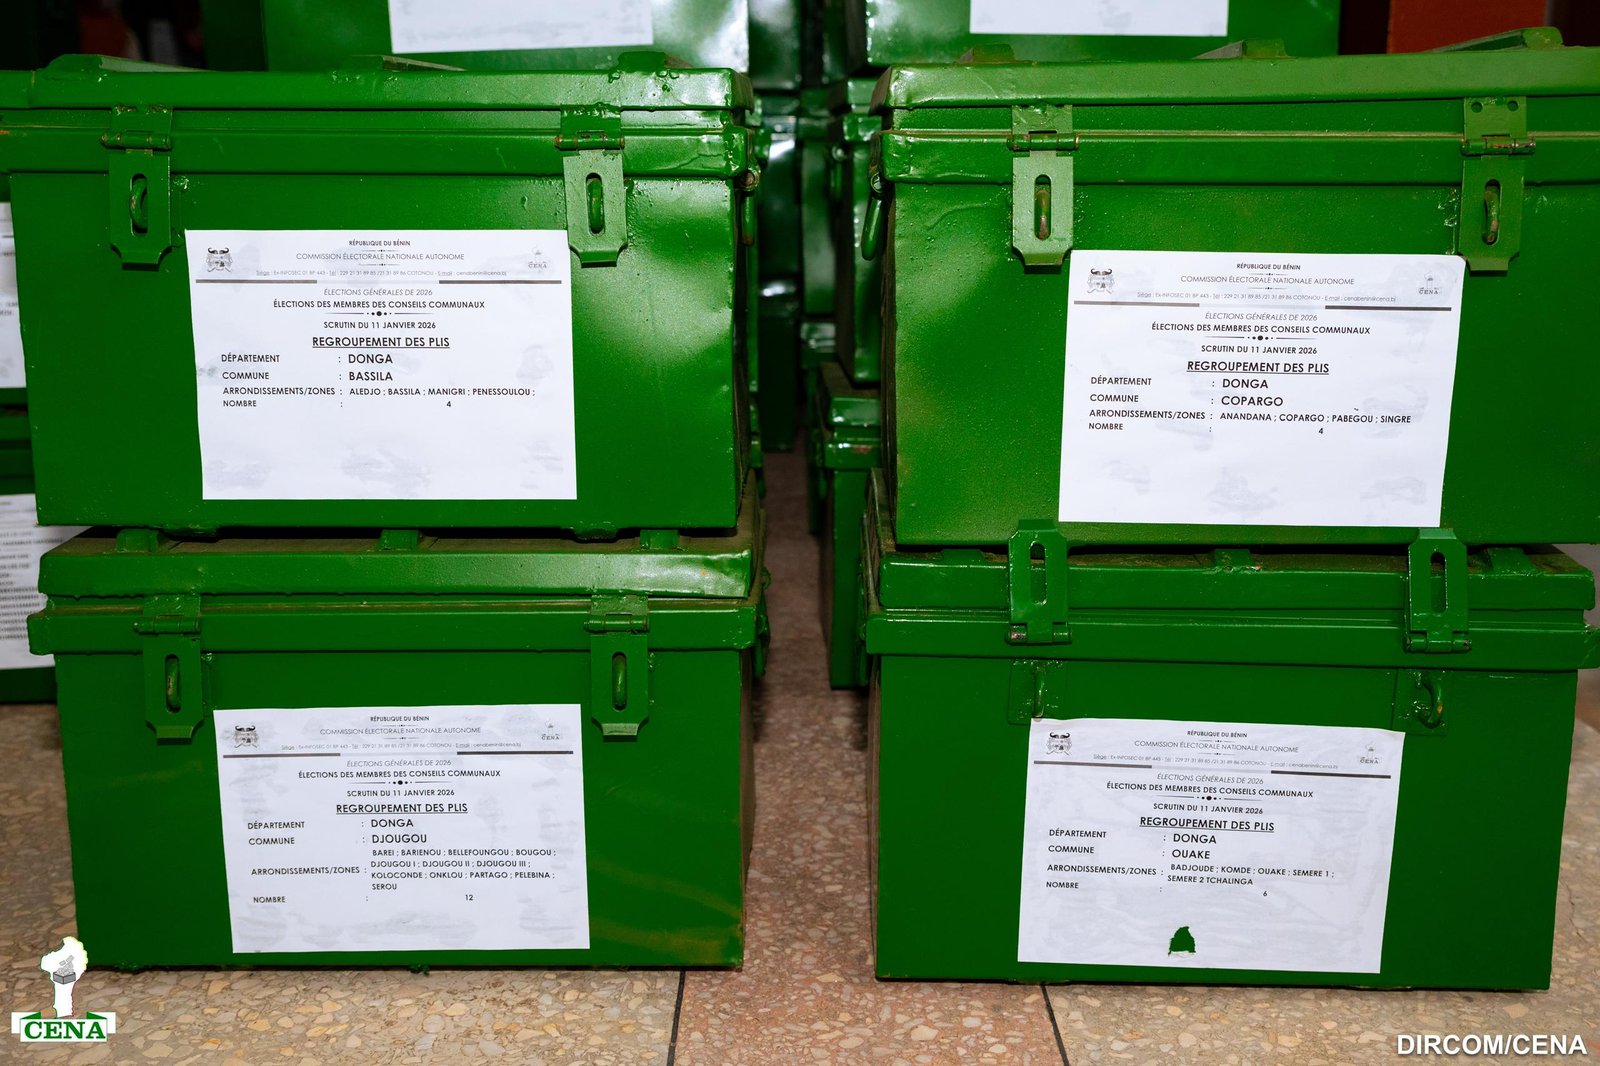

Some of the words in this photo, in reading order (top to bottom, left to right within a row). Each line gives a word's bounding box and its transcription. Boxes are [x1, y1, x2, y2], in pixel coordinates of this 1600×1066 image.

[296, 253, 342, 262] COMMISSION
[342, 253, 384, 261] ÉLECTORALE
[1228, 275, 1272, 284] ÉLECTORALE
[363, 288, 404, 296] GÉNÉRALES
[273, 299, 315, 308] ÉLECTIONS
[1205, 311, 1244, 320] ÉLECTIONS
[1246, 312, 1288, 321] GÉNÉRALES
[1152, 322, 1194, 331] ÉLECTIONS
[1270, 326, 1310, 334] CONSEILS
[1312, 326, 1371, 334] COMMUNAUX
[312, 337, 402, 346] REGROUPEMENT
[405, 337, 426, 346] DES
[429, 337, 450, 346] PLIS
[221, 353, 280, 363] DÉPARTEMENT
[348, 354, 393, 364] DONGA
[1187, 361, 1280, 372] REGROUPEMENT
[1284, 363, 1304, 372] DES
[1308, 363, 1329, 373] PLIS
[222, 372, 270, 380] COMMUNE
[349, 371, 393, 381] BASSILA
[1091, 375, 1152, 386] DÉPARTEMENT
[1222, 378, 1269, 389] DONGA
[223, 387, 336, 396] ARRONDISSEMENTS/ZONES
[1090, 394, 1139, 402] COMMUNE
[1221, 396, 1284, 407] COPARGO
[1089, 409, 1206, 420] ARRONDISSEMENTS/ZONES
[1220, 413, 1272, 421] ANANDANA
[1279, 414, 1325, 422] COPARGO
[1332, 415, 1374, 423] PABEGOU
[1380, 415, 1412, 423] SINGRE
[443, 727, 481, 735] AUTONOME
[298, 770, 338, 779] ÉLECTIONS
[1107, 781, 1147, 791] ÉLECTIONS
[1165, 785, 1201, 793] MEMBRES
[1219, 787, 1256, 796] CONSEILS
[1258, 789, 1314, 798] COMMUNAUX
[336, 804, 422, 812] REGROUPEMENT
[425, 803, 445, 812] DES
[448, 803, 468, 812] PLIS
[247, 820, 305, 830] DÉPARTEMENT
[371, 819, 414, 828] DONGA
[1140, 816, 1228, 829] REGROUPEMENT
[1231, 821, 1251, 830] DES
[1254, 822, 1274, 830] PLIS
[248, 837, 295, 846] COMMUNE
[372, 834, 427, 844] DJOUGOU
[1049, 828, 1107, 838] DÉPARTEMENT
[1173, 833, 1217, 844] DONGA
[1048, 845, 1094, 854] COMMUNE
[1172, 849, 1210, 859] OUAKE
[251, 866, 360, 876] ARRONDISSEMENTS/ZONES
[1047, 864, 1157, 875] ARRONDISSEMENTS/ZONES
[1171, 864, 1214, 872] BADJOUDE
[1168, 875, 1197, 883] SEMERE
[1206, 877, 1253, 885] TCHALINGA
